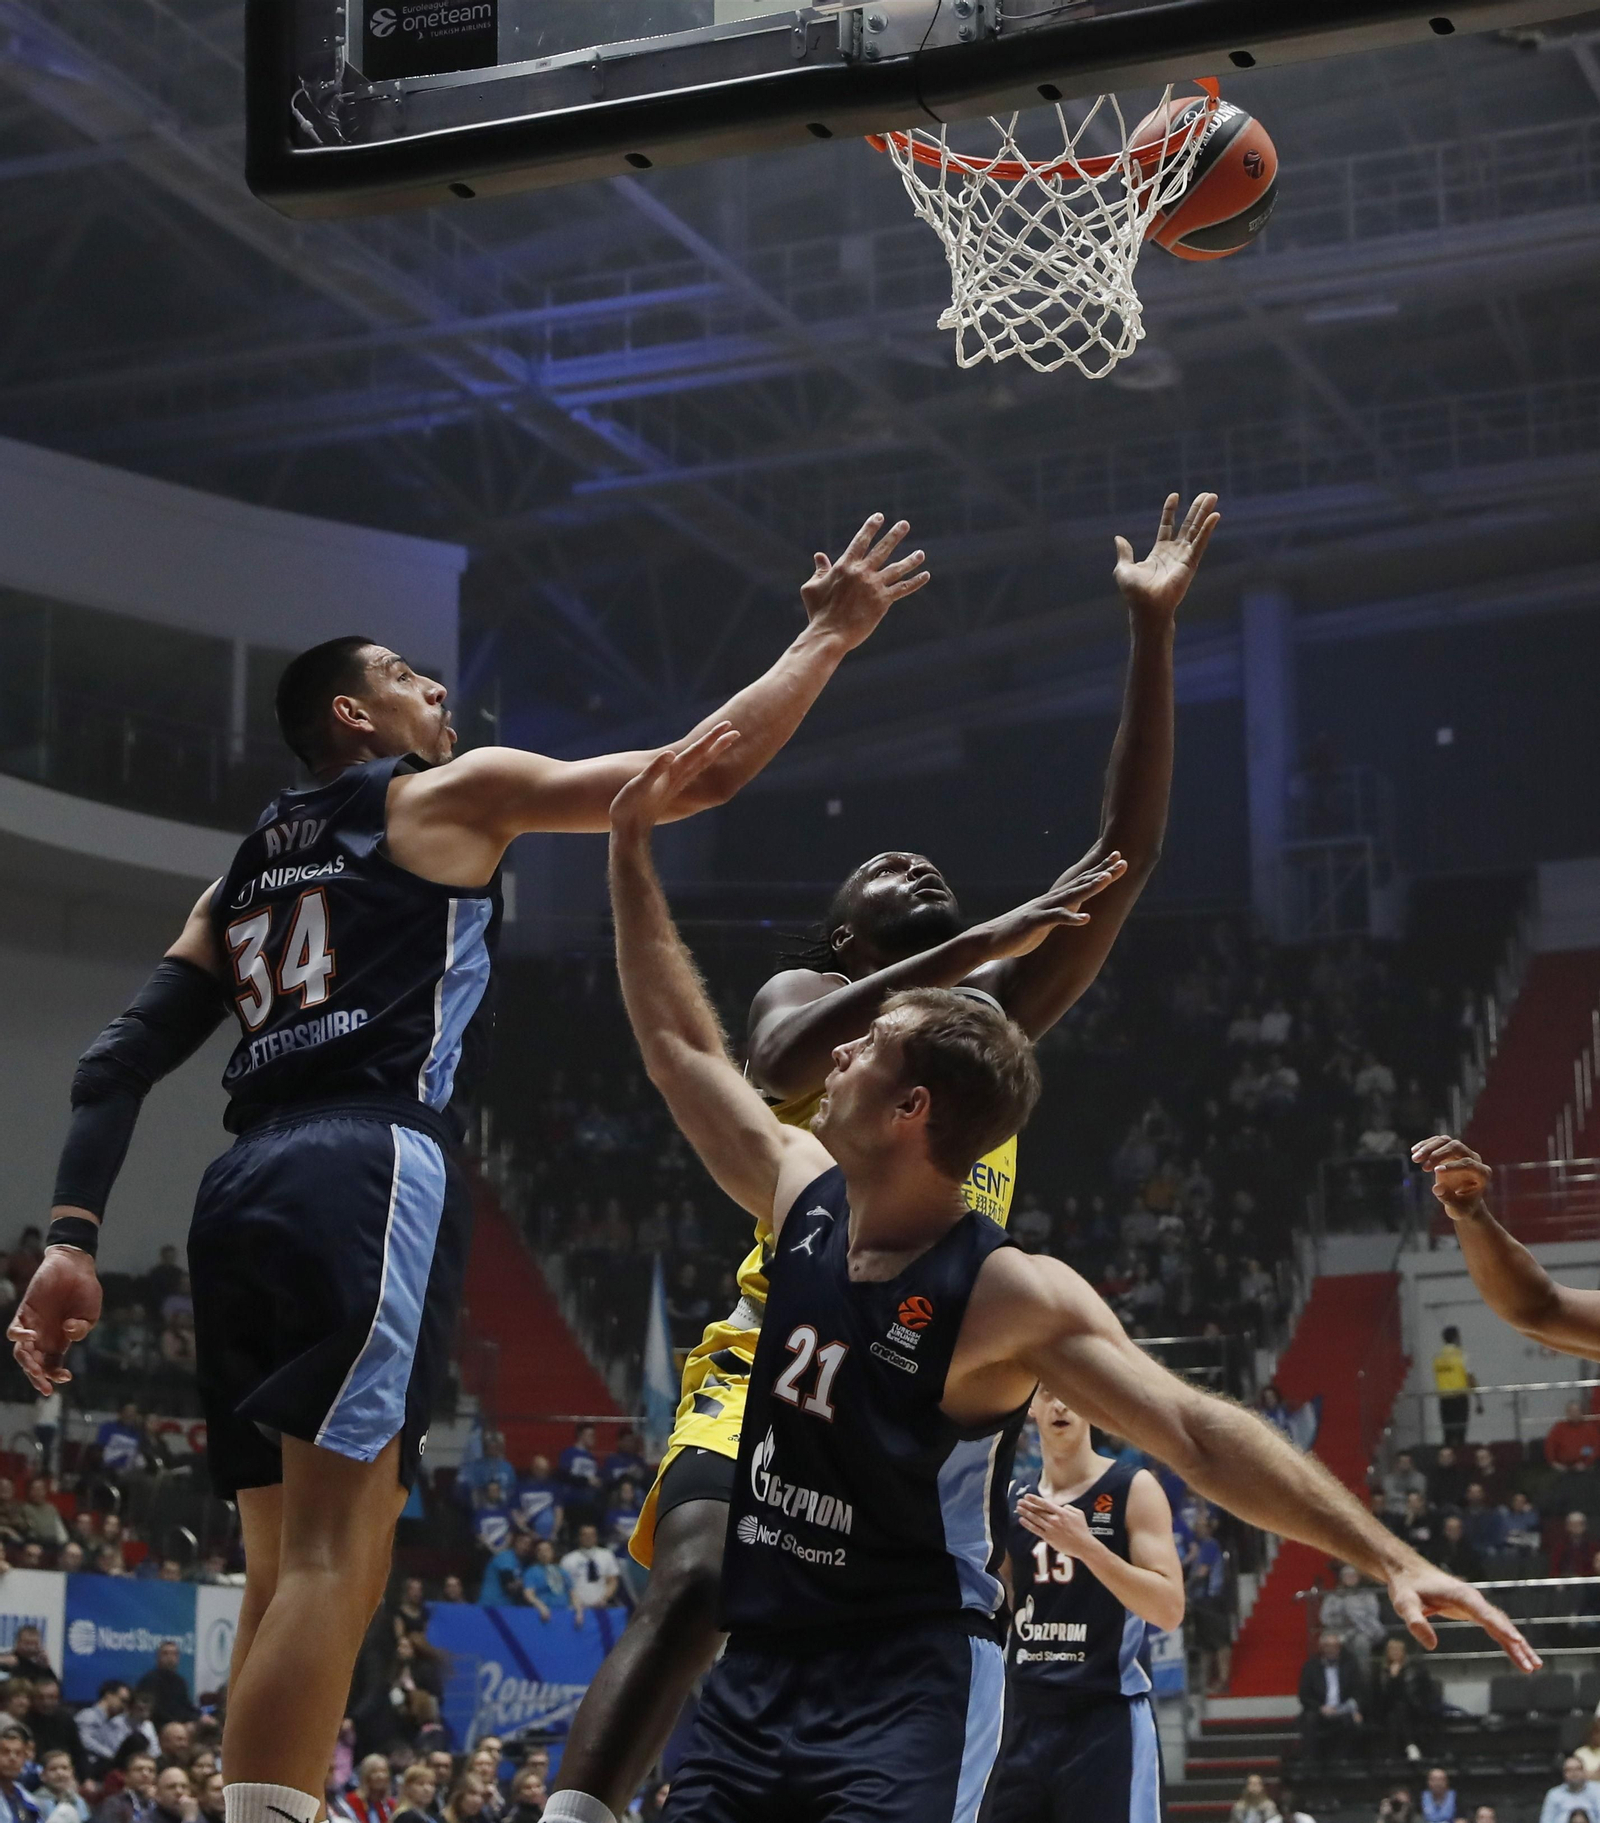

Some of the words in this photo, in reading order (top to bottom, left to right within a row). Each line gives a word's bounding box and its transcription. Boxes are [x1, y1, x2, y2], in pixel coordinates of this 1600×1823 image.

[402, 0, 448, 14] Euroleague
[402, 4, 491, 31] oneteam
[430, 28, 459, 38] TURKISH
[461, 21, 491, 32] AIRLINES
[261, 855, 344, 889] NIPIGAS
[226, 886, 336, 1031] 34
[963, 1162, 1010, 1201] ENT
[889, 1329, 918, 1345] AIRLINES
[892, 1322, 922, 1340] TURKISH
[870, 1342, 918, 1373] oneteam
[771, 1324, 849, 1423] 21
[834, 1548, 846, 1566] 2
[1015, 1603, 1087, 1642] GAZPROM
[1078, 1652, 1086, 1662] 2
